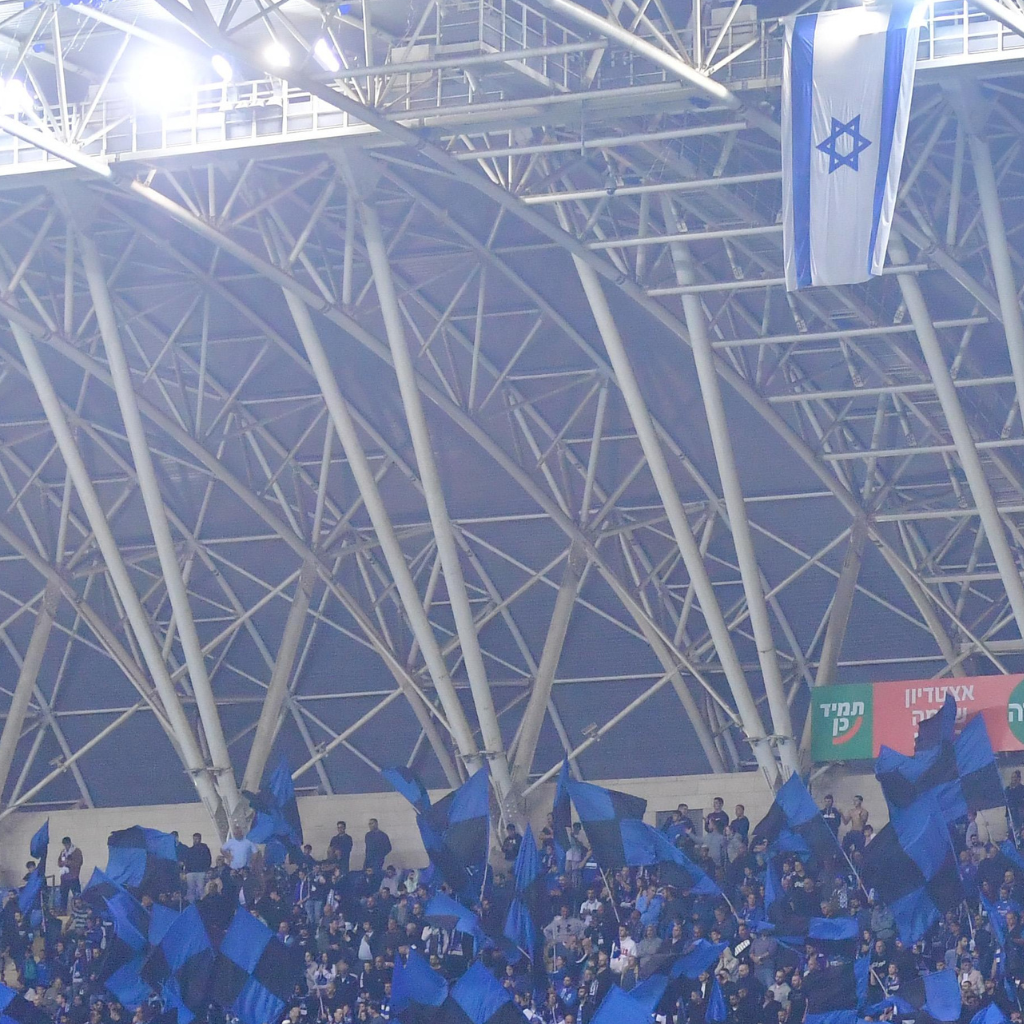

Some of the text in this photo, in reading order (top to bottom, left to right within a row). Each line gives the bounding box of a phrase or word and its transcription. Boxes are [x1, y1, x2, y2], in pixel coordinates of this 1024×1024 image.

[905, 685, 975, 709] אצטדיון
[819, 701, 865, 718] תמיד
[832, 716, 849, 736] כן
